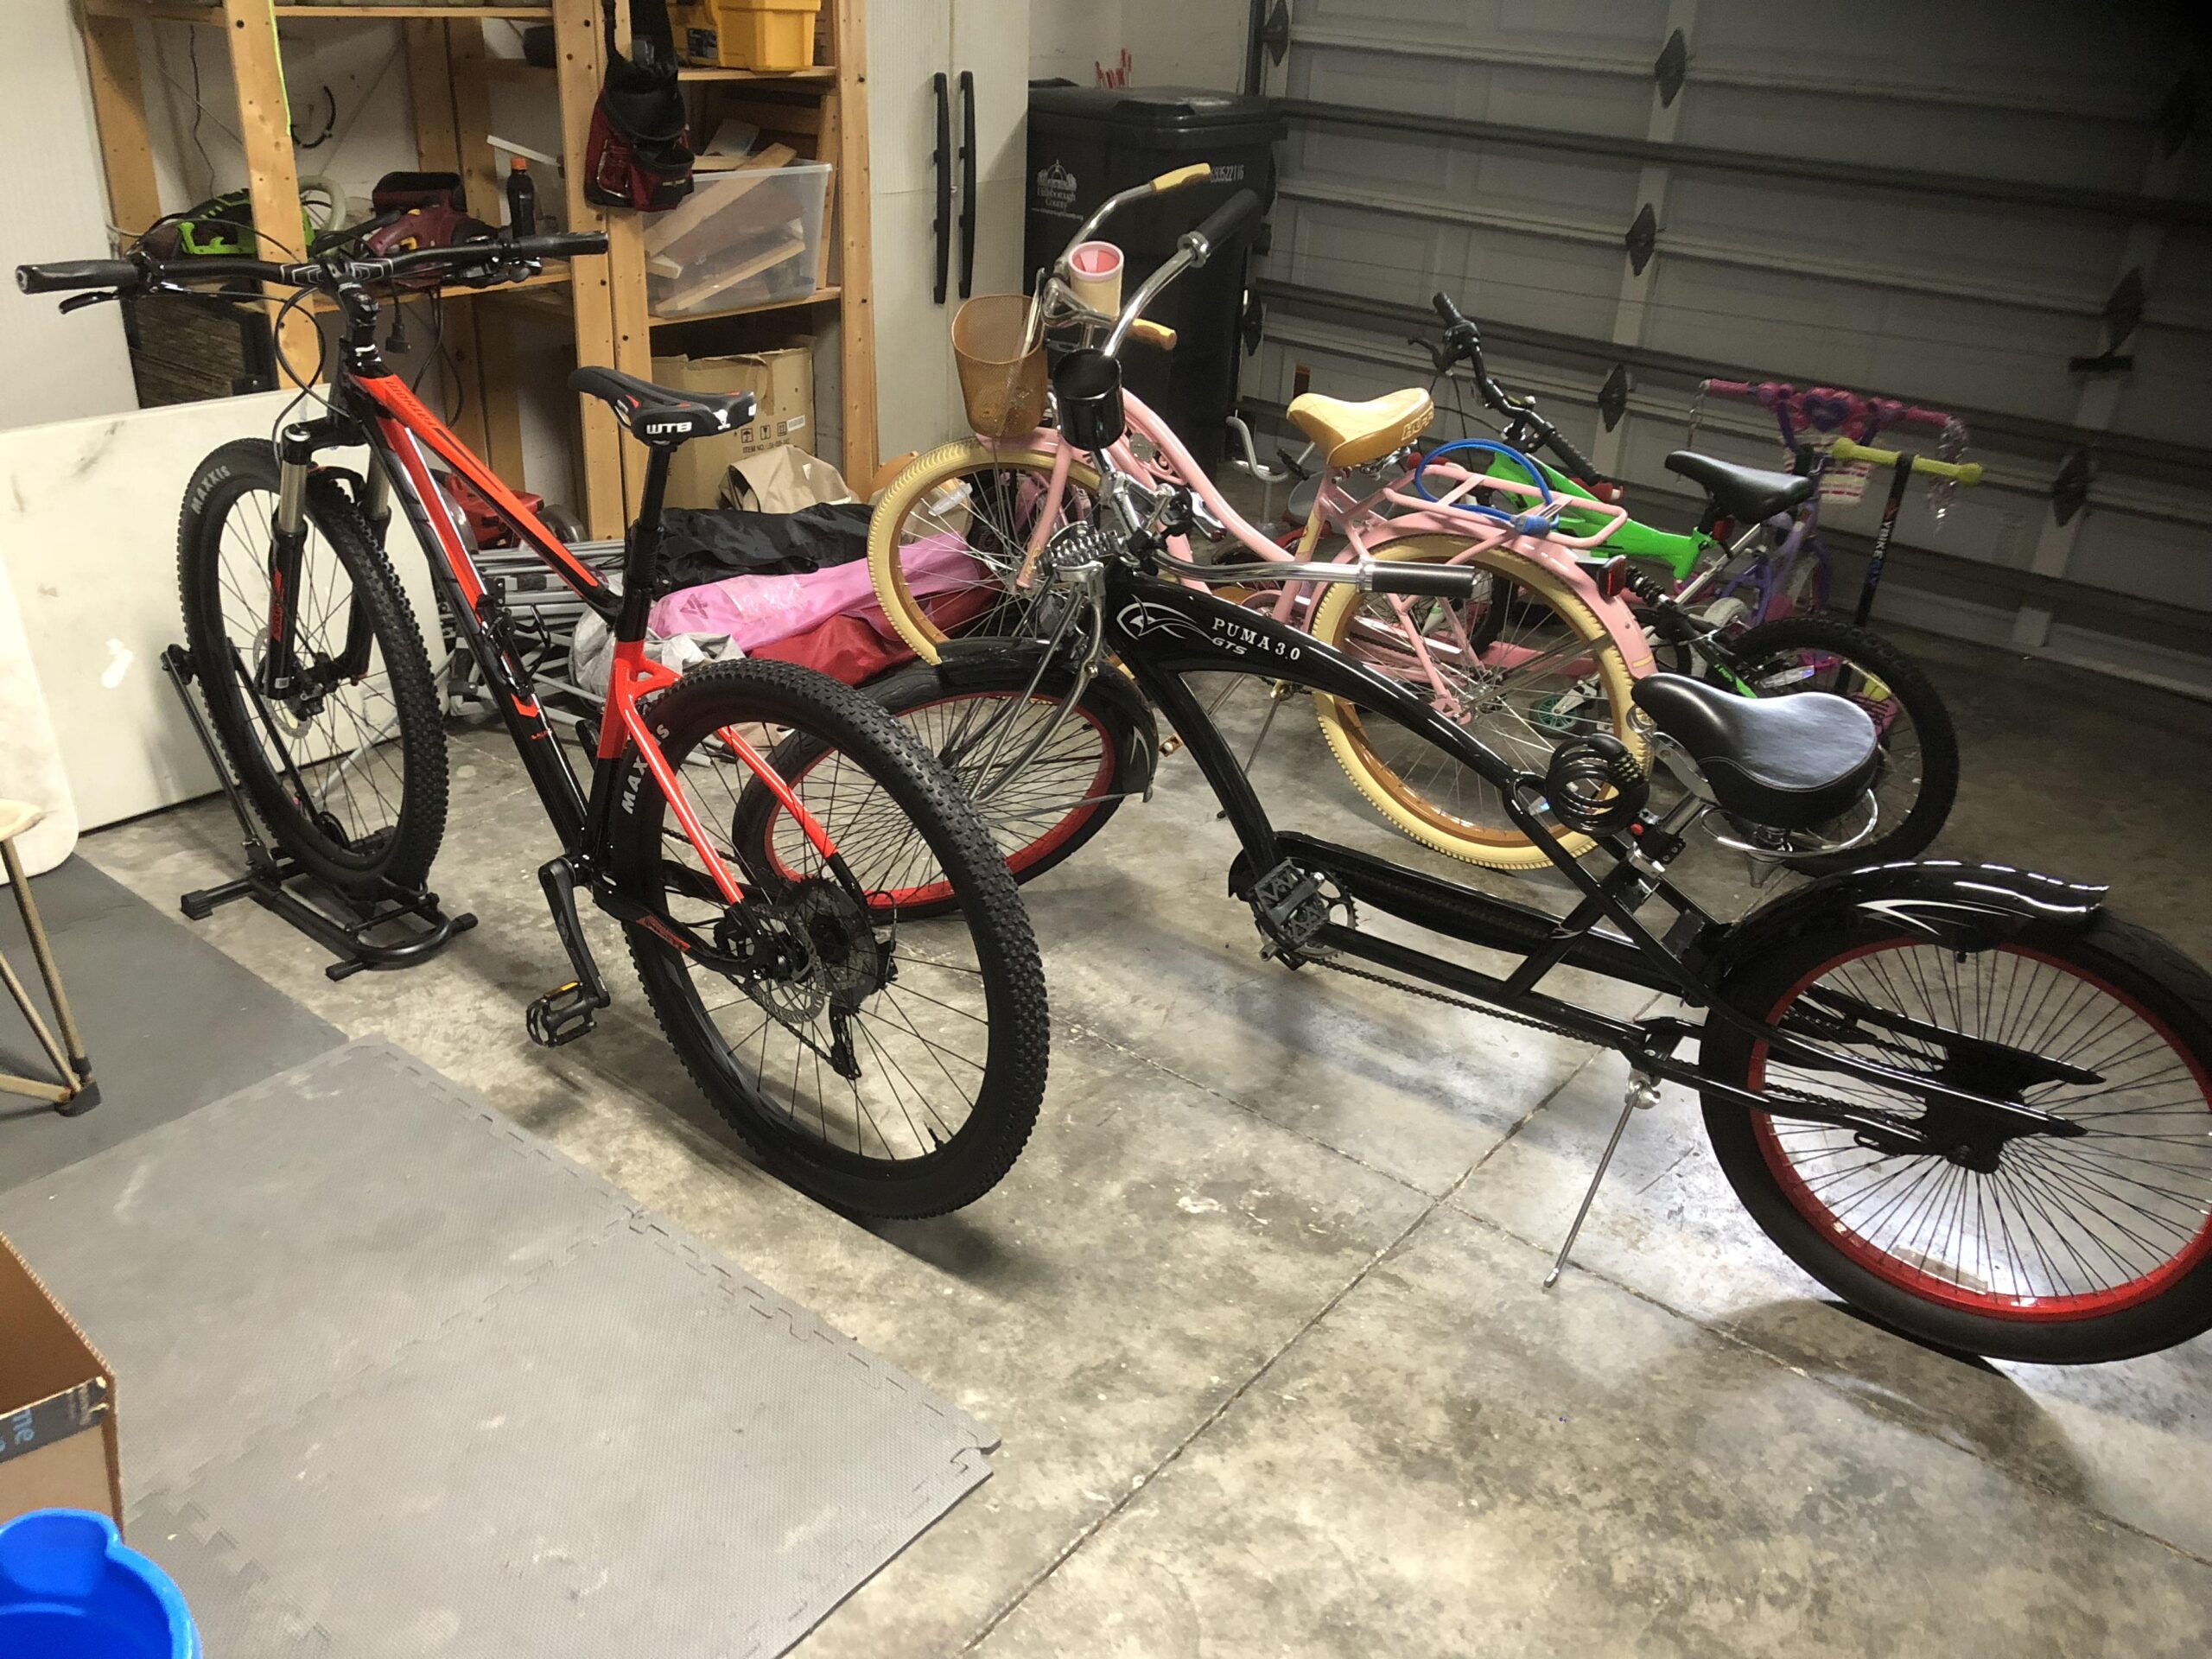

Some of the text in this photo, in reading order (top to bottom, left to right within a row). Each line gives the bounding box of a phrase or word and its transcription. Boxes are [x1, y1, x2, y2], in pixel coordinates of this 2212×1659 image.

[646, 422, 693, 434] WTB
[191, 465, 232, 515] MAXXIS
[1211, 616, 1301, 661] PUMA 3.0
[1211, 636, 1248, 655] GTS
[621, 724, 671, 815] MAXS
